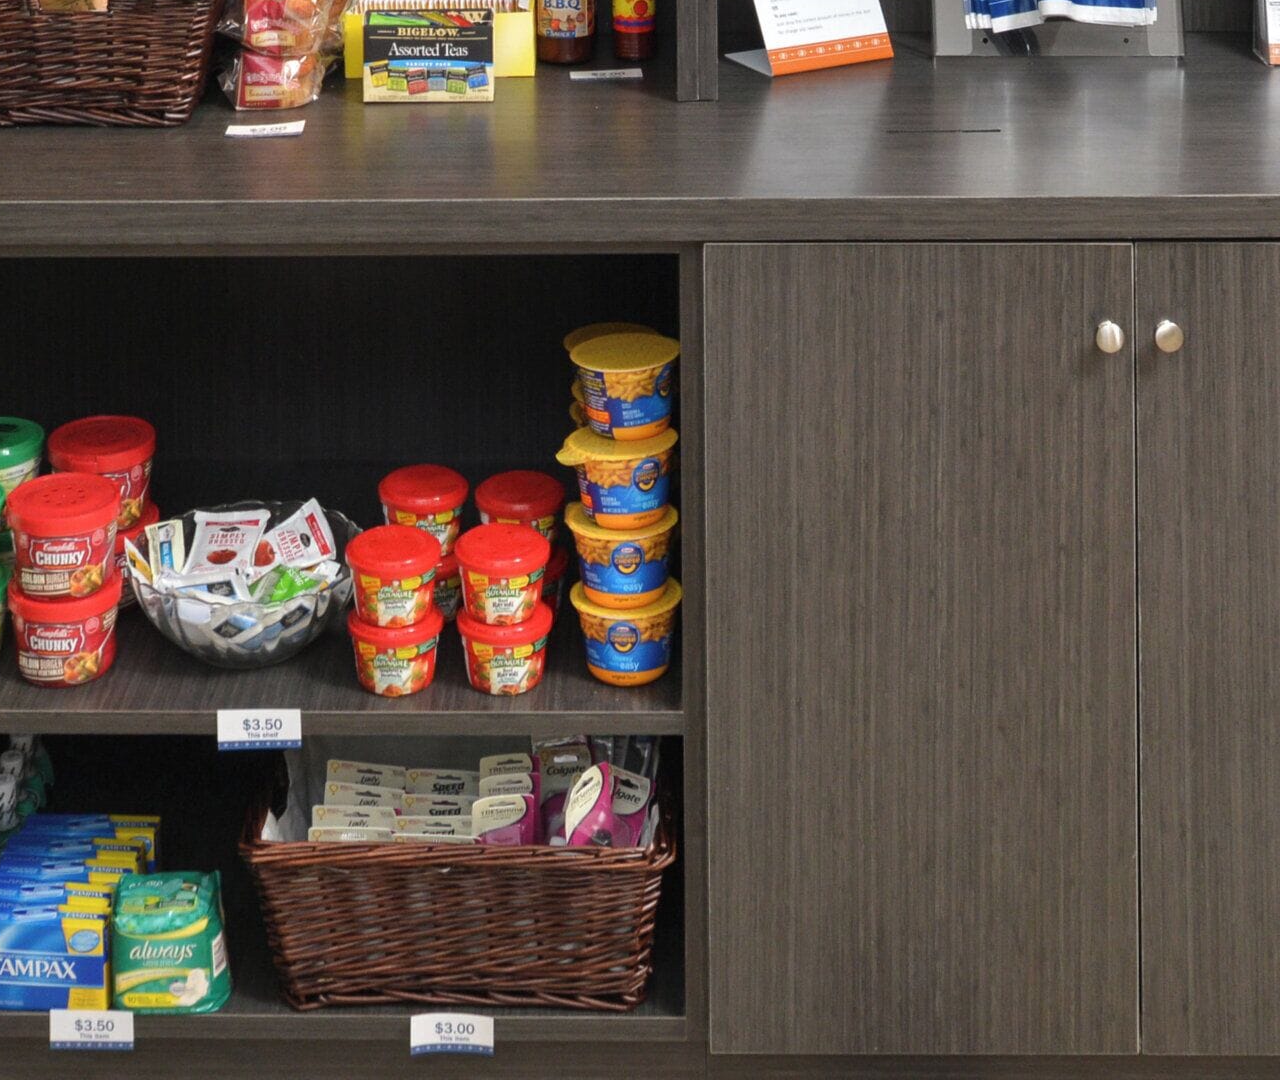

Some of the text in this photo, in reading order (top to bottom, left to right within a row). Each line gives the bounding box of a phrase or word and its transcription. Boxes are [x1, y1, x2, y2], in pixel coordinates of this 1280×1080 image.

[397, 27, 460, 37] BIGELOW
[388, 42, 468, 57] Assorted Teas
[35, 551, 85, 566] CHUNKY
[29, 636, 78, 652] CHUNKY
[242, 718, 283, 732] $3.50
[546, 765, 587, 776] Colgate
[129, 939, 196, 961] always
[74, 1020, 115, 1032] $3.50
[435, 1023, 475, 1035] $3.00
